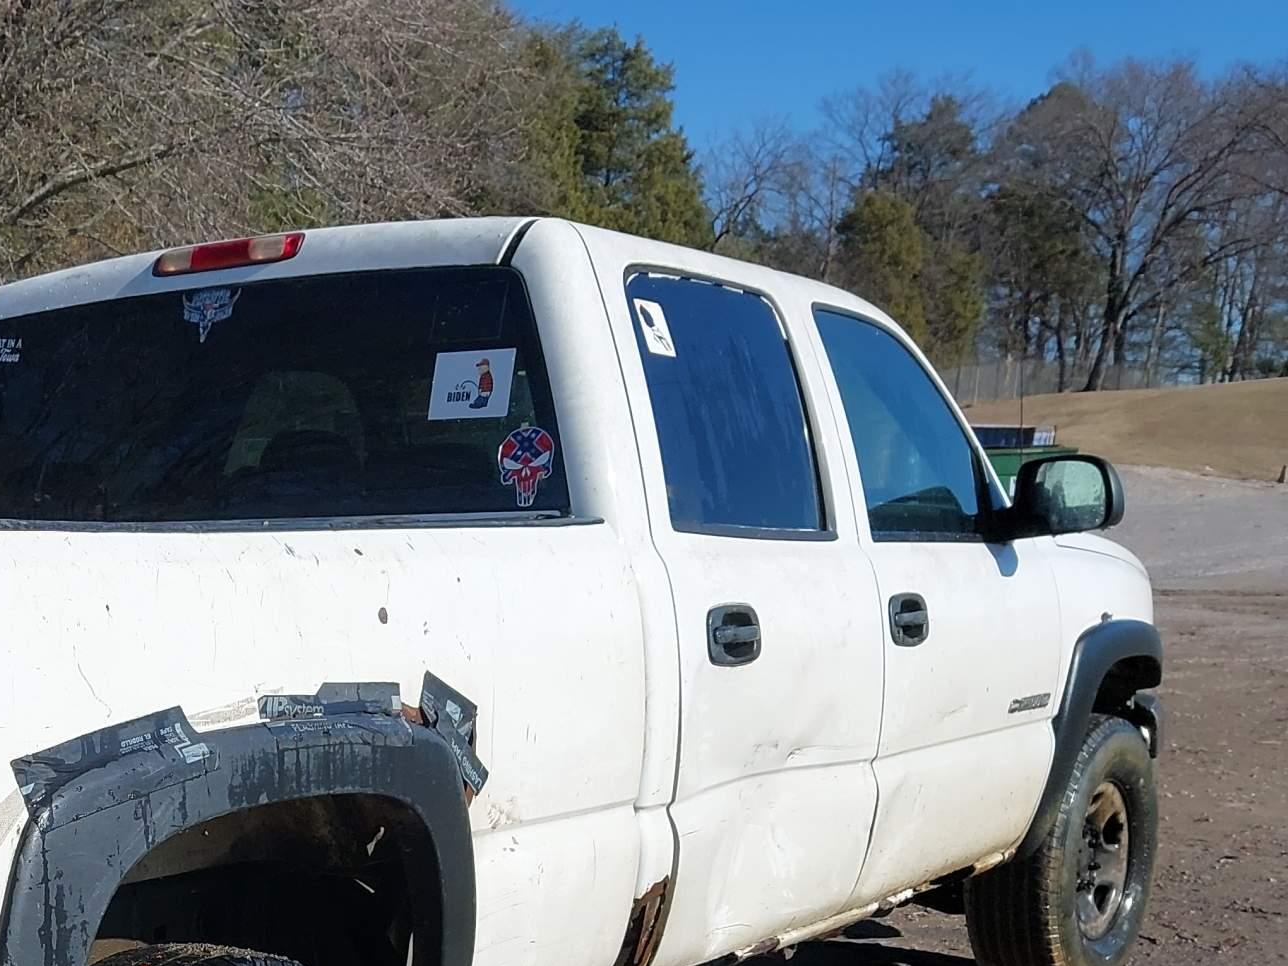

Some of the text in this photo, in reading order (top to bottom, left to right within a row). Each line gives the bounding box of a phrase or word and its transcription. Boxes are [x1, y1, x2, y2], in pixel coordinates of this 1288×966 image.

[7, 338, 16, 348] IN
[16, 338, 23, 348] A
[446, 391, 471, 403] BIDEN
